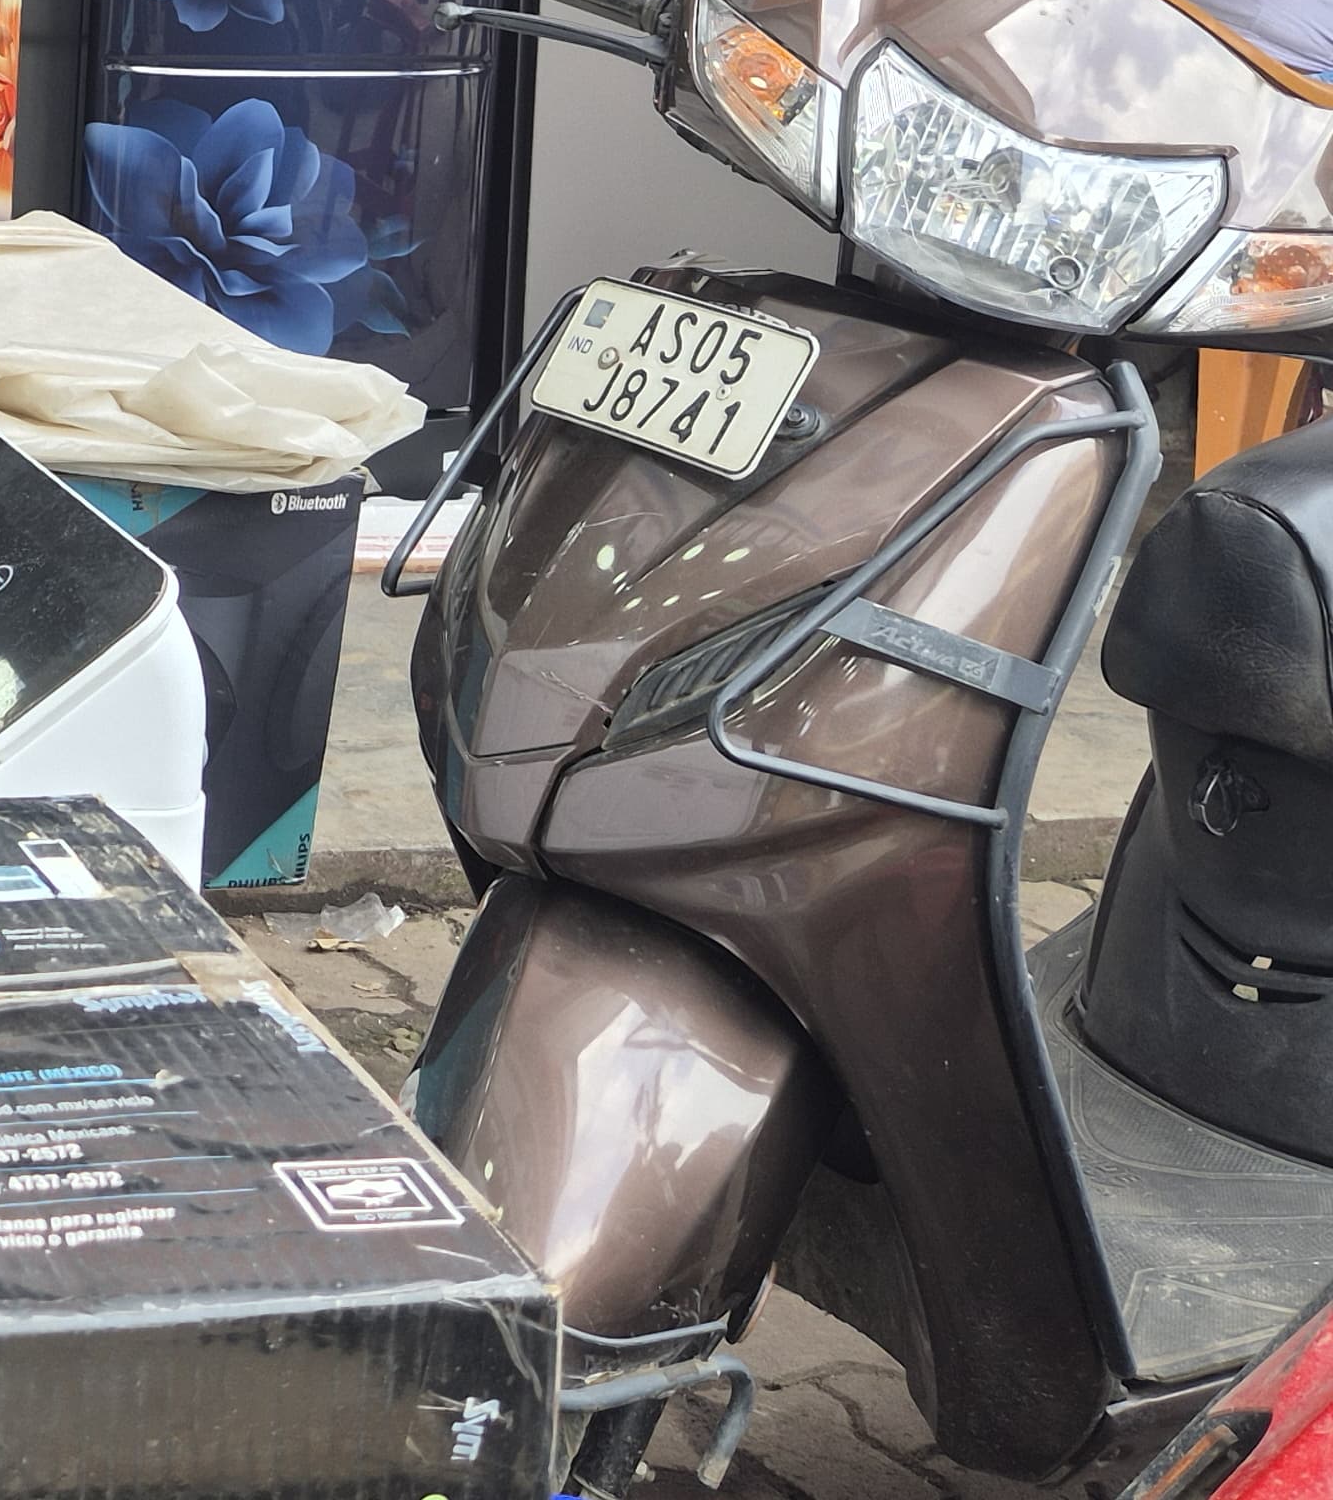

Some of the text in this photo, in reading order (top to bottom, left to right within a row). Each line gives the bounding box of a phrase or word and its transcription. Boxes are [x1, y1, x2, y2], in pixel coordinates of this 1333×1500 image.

[567, 335, 593, 355] IND
[629, 303, 763, 385] AS05
[582, 362, 742, 456] J8741
[287, 493, 347, 511] Bluetooth
[294, 833, 311, 880] HILIPS
[50, 1213, 94, 1232] para
[96, 1206, 176, 1227] registrar
